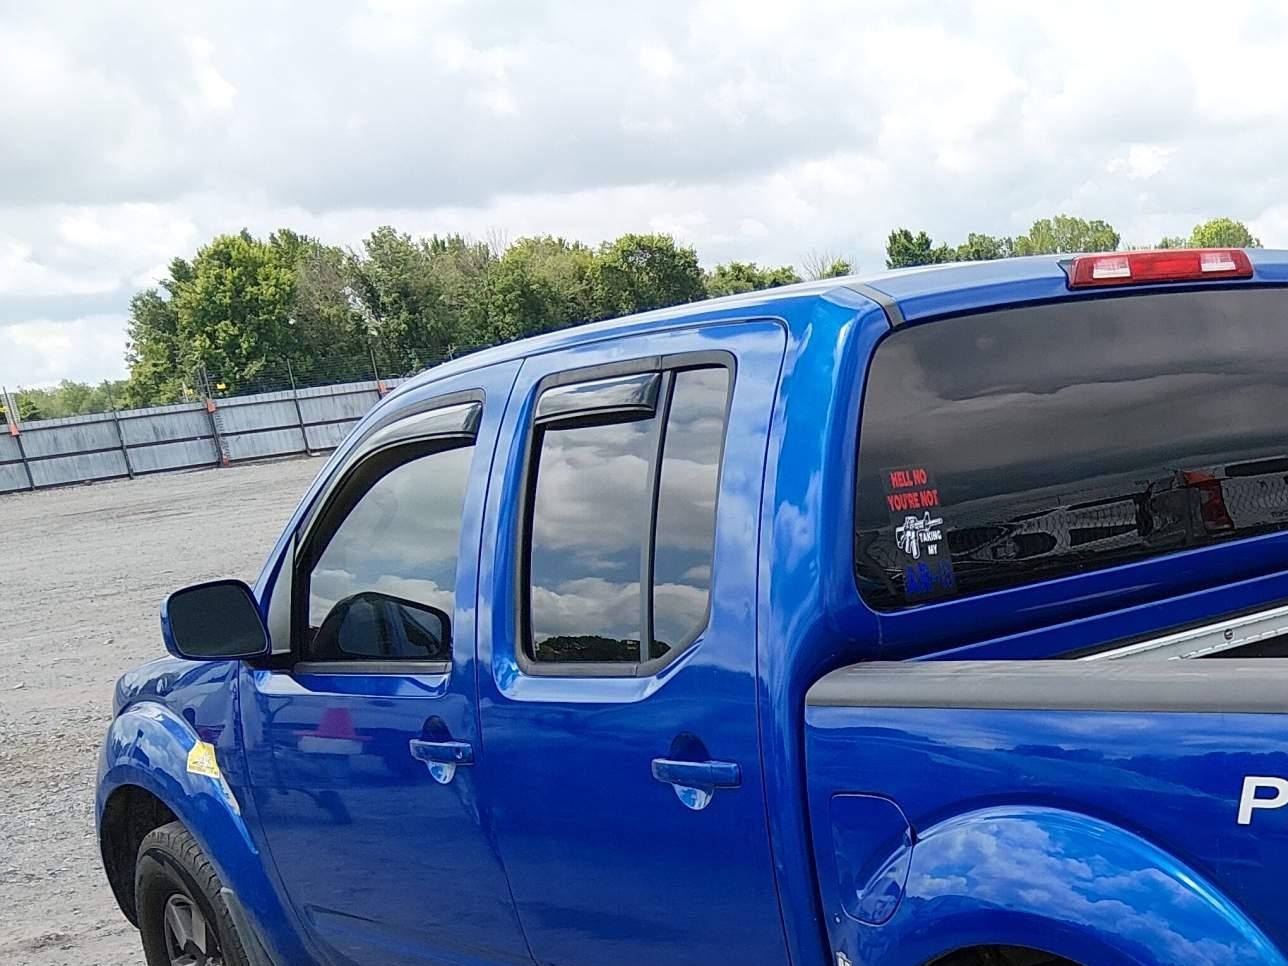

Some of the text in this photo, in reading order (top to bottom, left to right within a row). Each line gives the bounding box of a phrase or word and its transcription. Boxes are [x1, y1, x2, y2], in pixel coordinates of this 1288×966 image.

[890, 468, 927, 488] HELL NO
[887, 489, 939, 512] YOU'RE NOT
[919, 529, 942, 543] TAKING
[928, 544, 938, 555] MY
